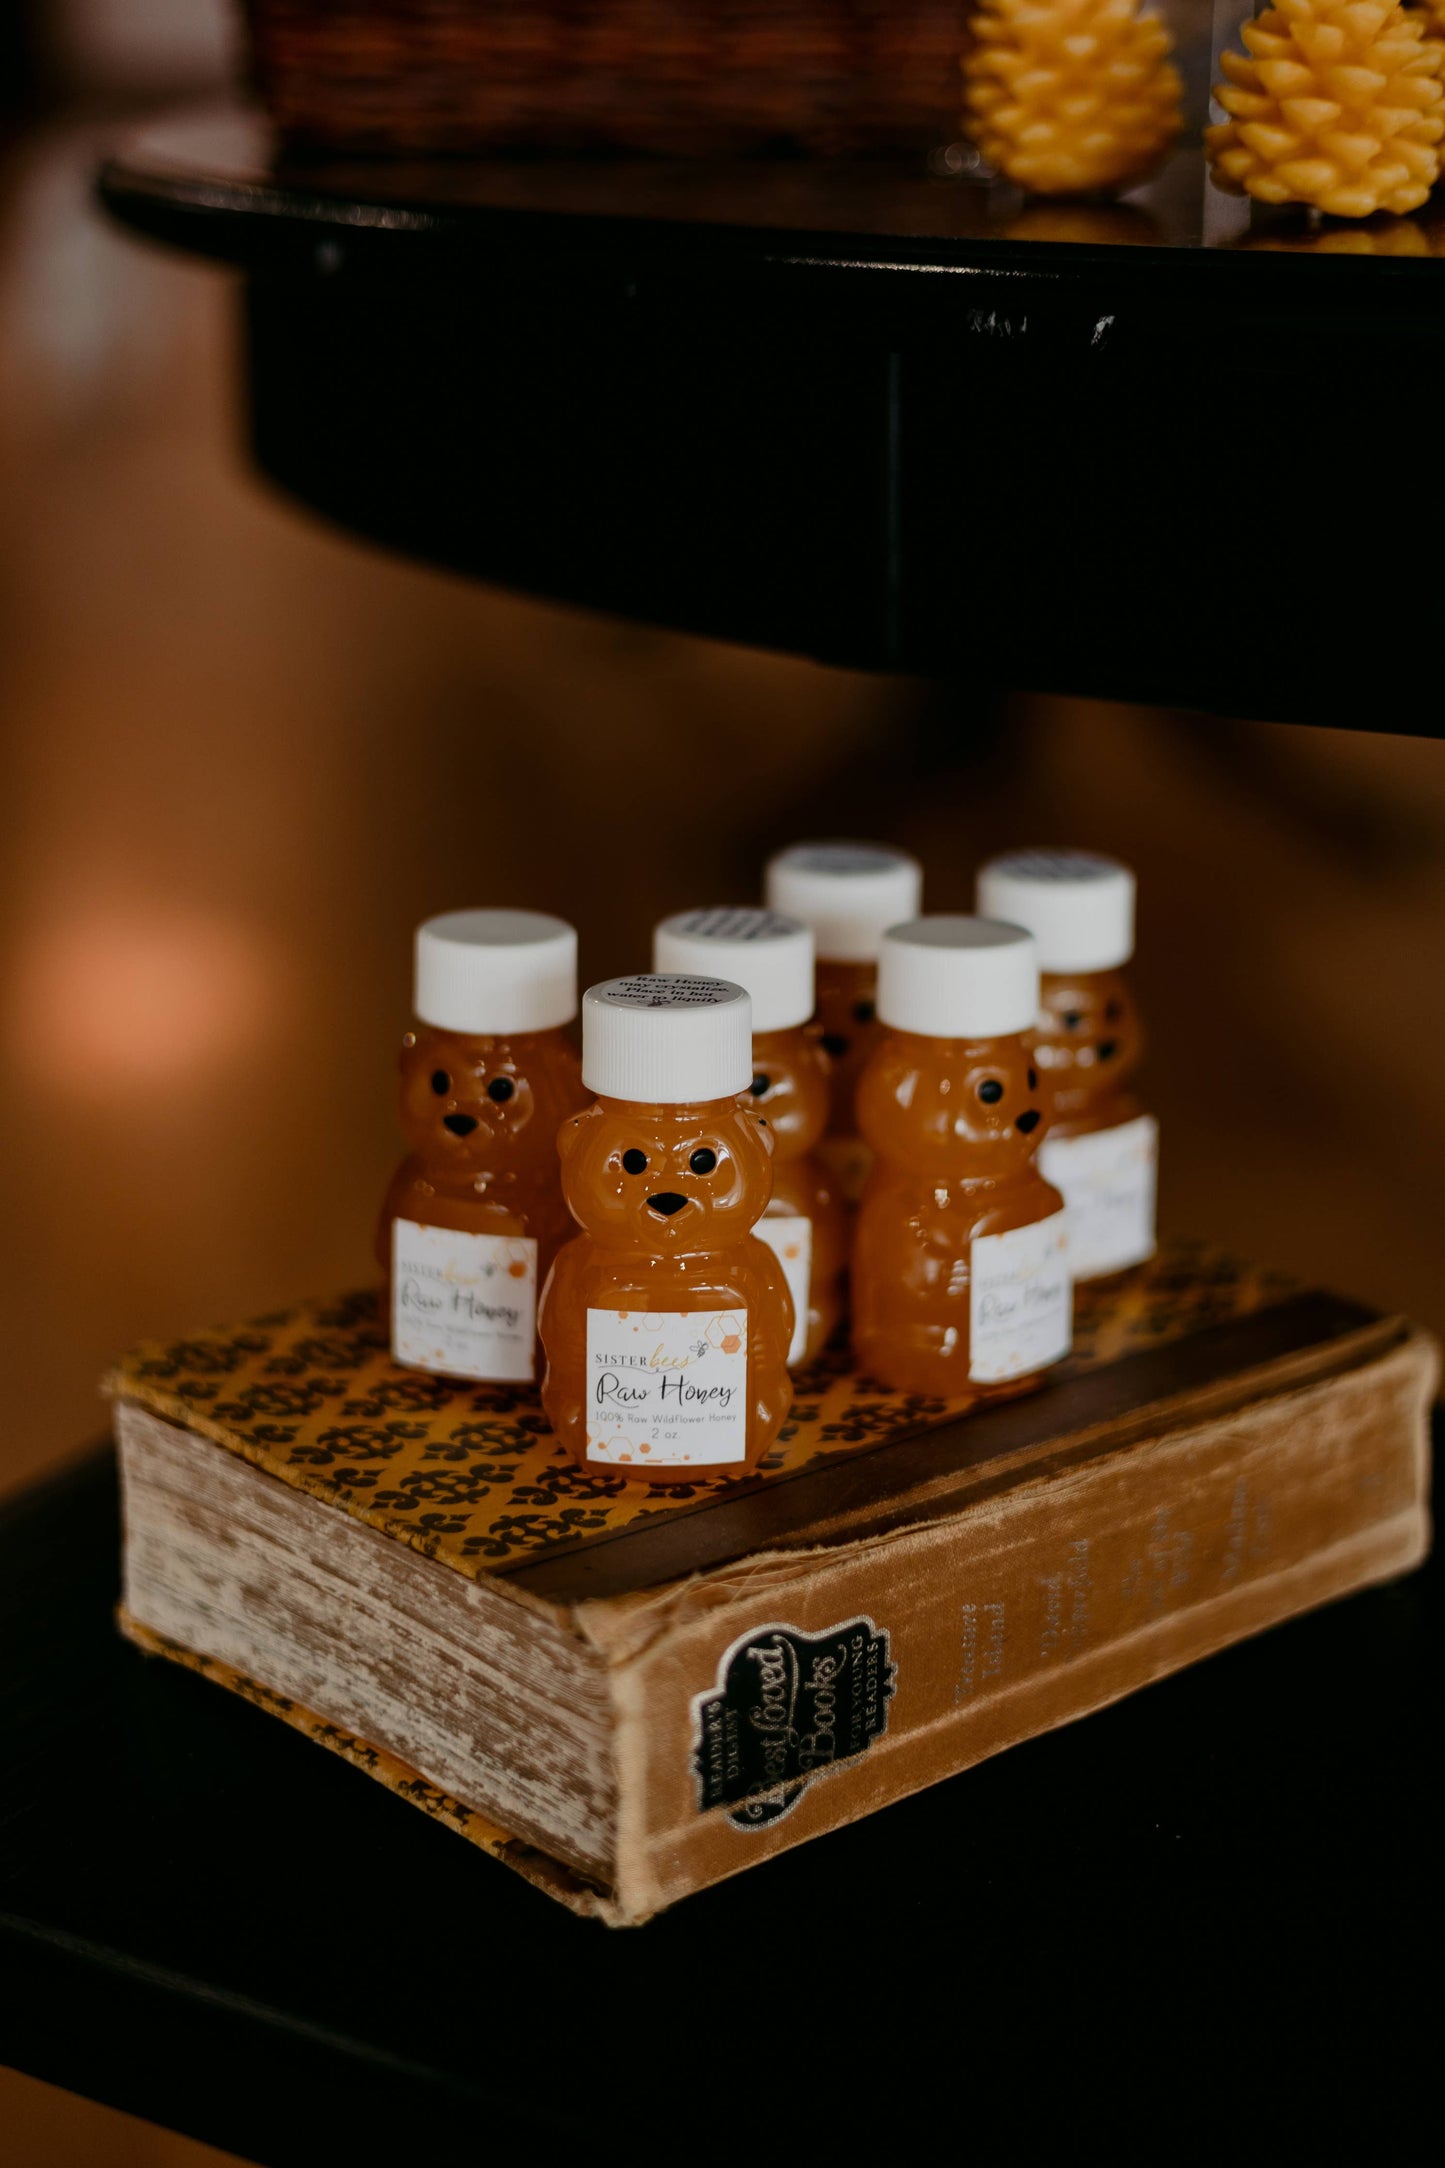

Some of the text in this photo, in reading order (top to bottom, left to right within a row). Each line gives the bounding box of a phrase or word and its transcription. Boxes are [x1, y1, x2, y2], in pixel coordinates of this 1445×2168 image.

[625, 987, 666, 995] Place
[674, 978, 725, 986] Honey
[607, 991, 650, 1000] water
[671, 995, 724, 1004] liquify
[596, 1372, 737, 1409] Raw Honey
[595, 1411, 737, 1424] 100% Raw Wildflower Honey
[651, 1427, 659, 1439] 2
[850, 1634, 865, 1712] YOUNG
[864, 1641, 880, 1730] READERS
[799, 1644, 848, 1771] Books
[724, 1708, 741, 1779] DIGEST
